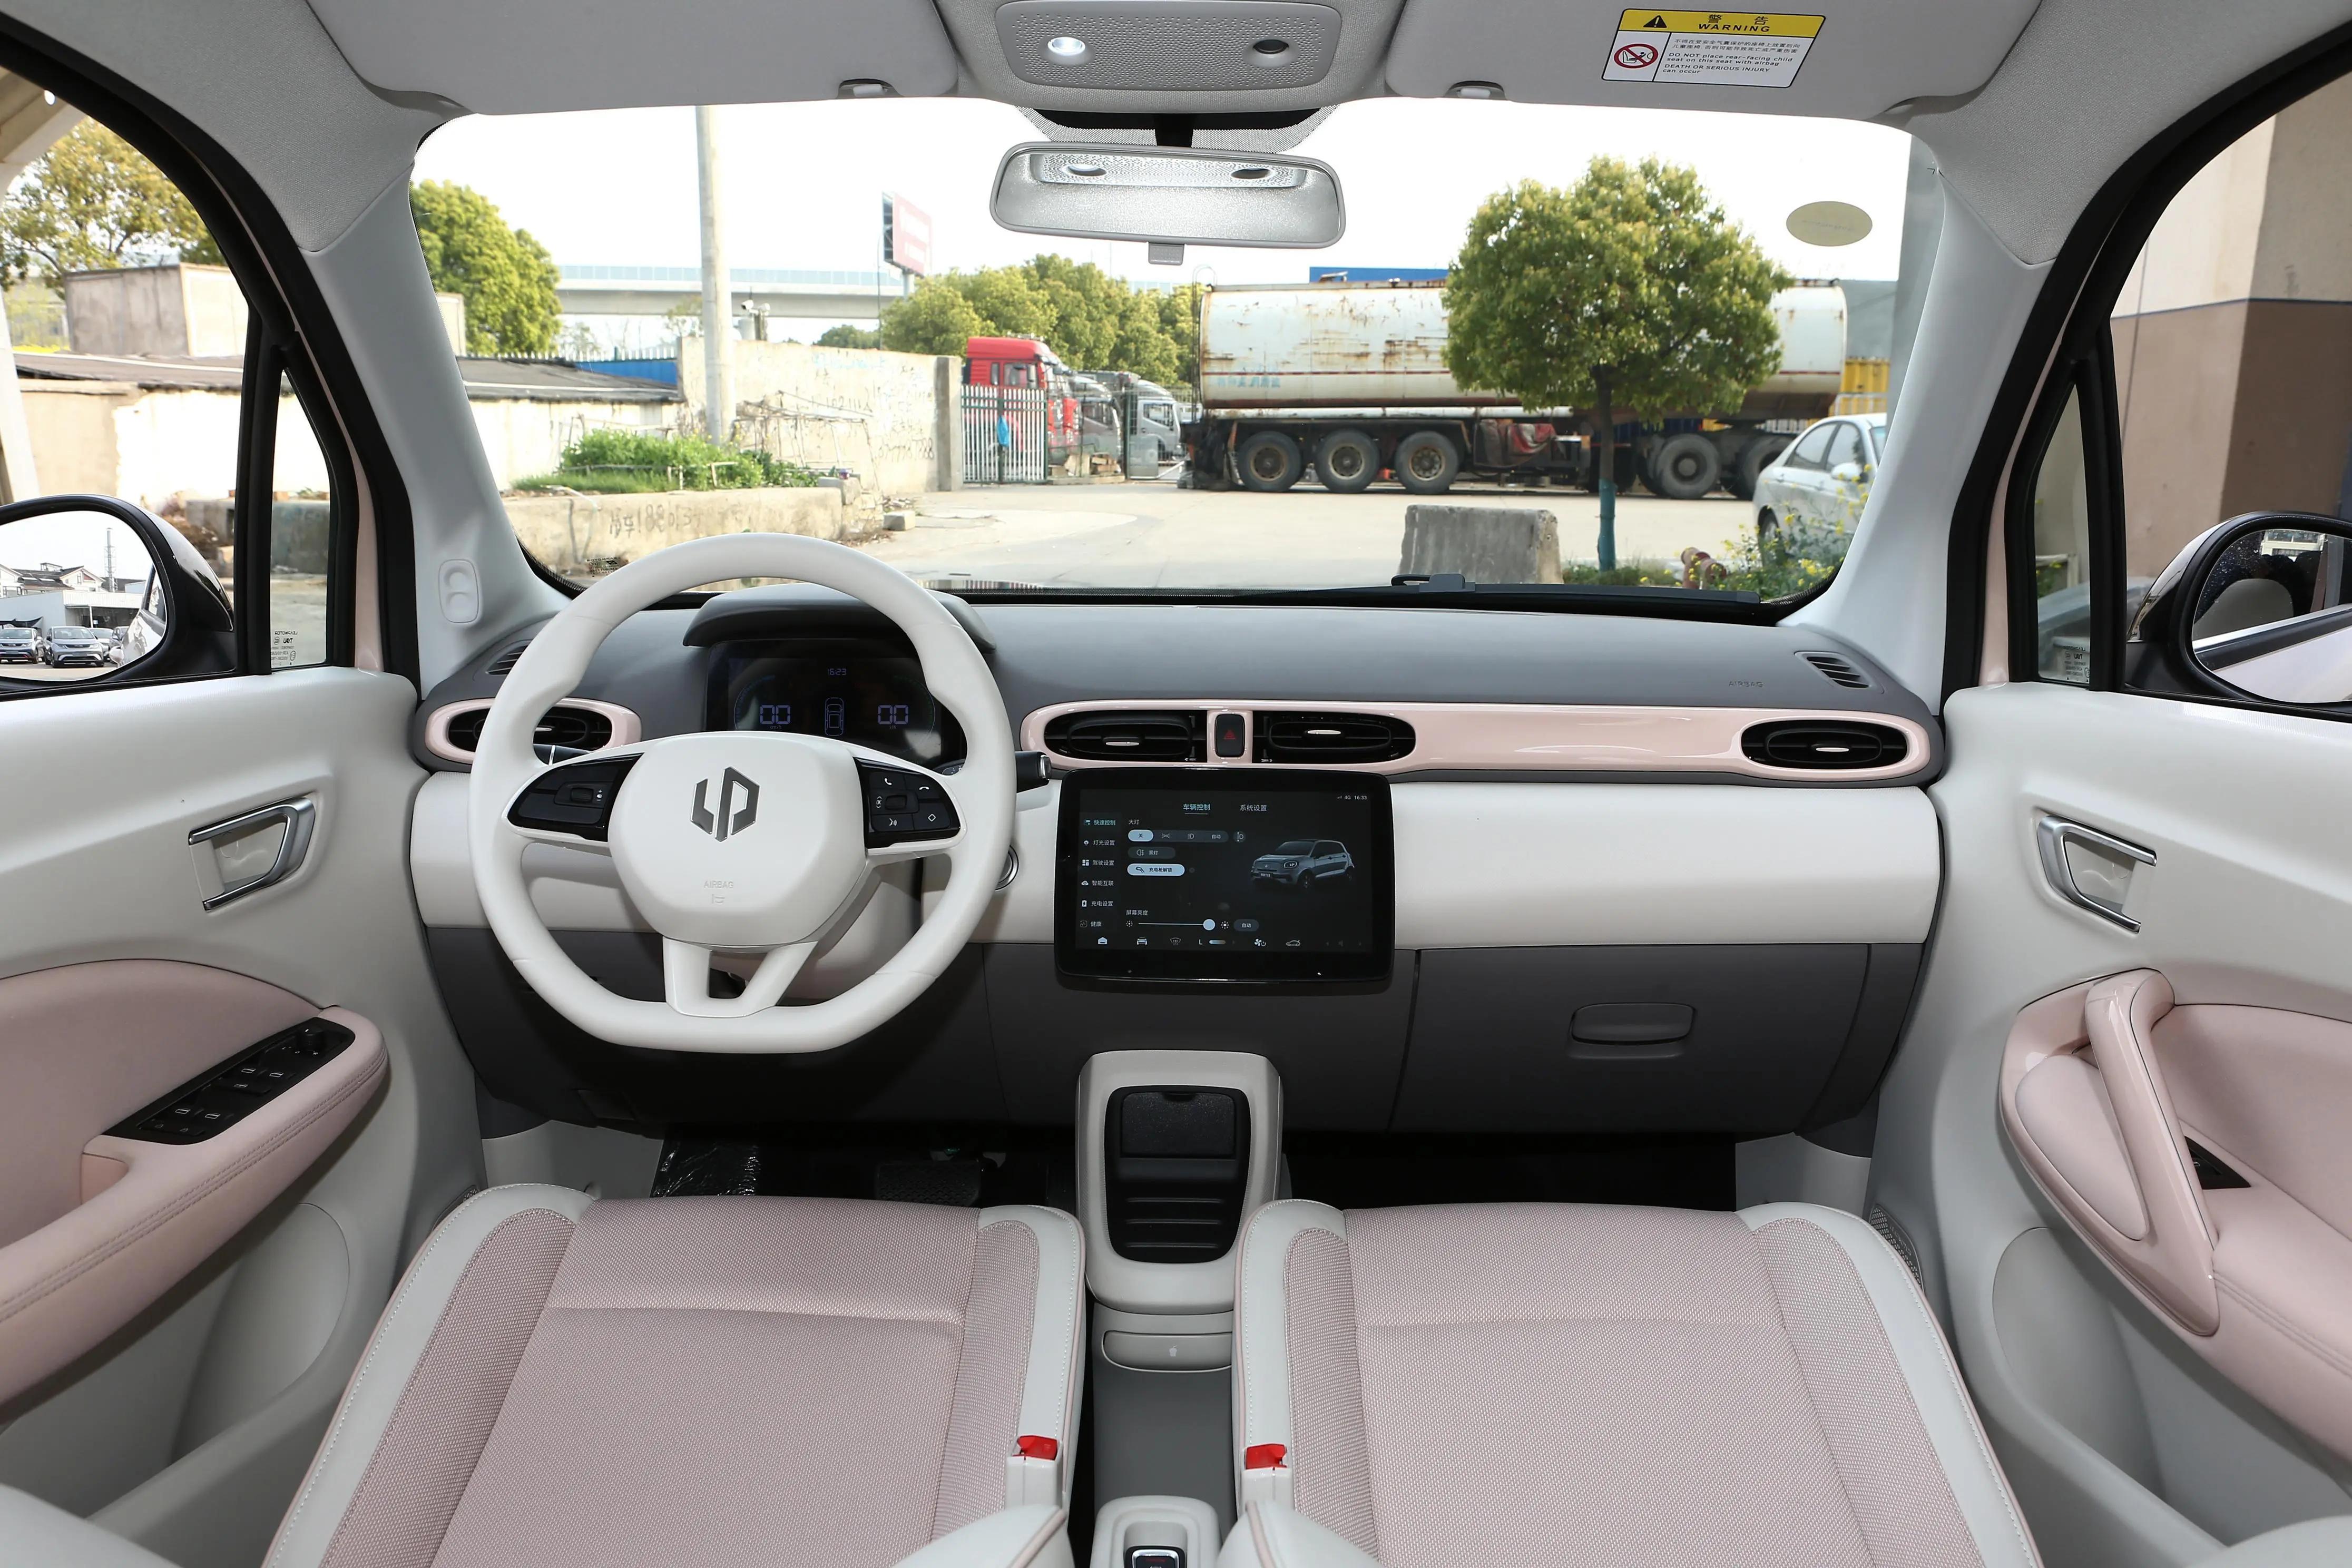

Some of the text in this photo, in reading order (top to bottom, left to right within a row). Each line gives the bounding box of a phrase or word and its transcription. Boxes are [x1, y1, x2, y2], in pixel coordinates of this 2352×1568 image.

[1698, 23, 1770, 32] WARNING
[760, 704, 790, 724] 00
[877, 704, 908, 724] 00
